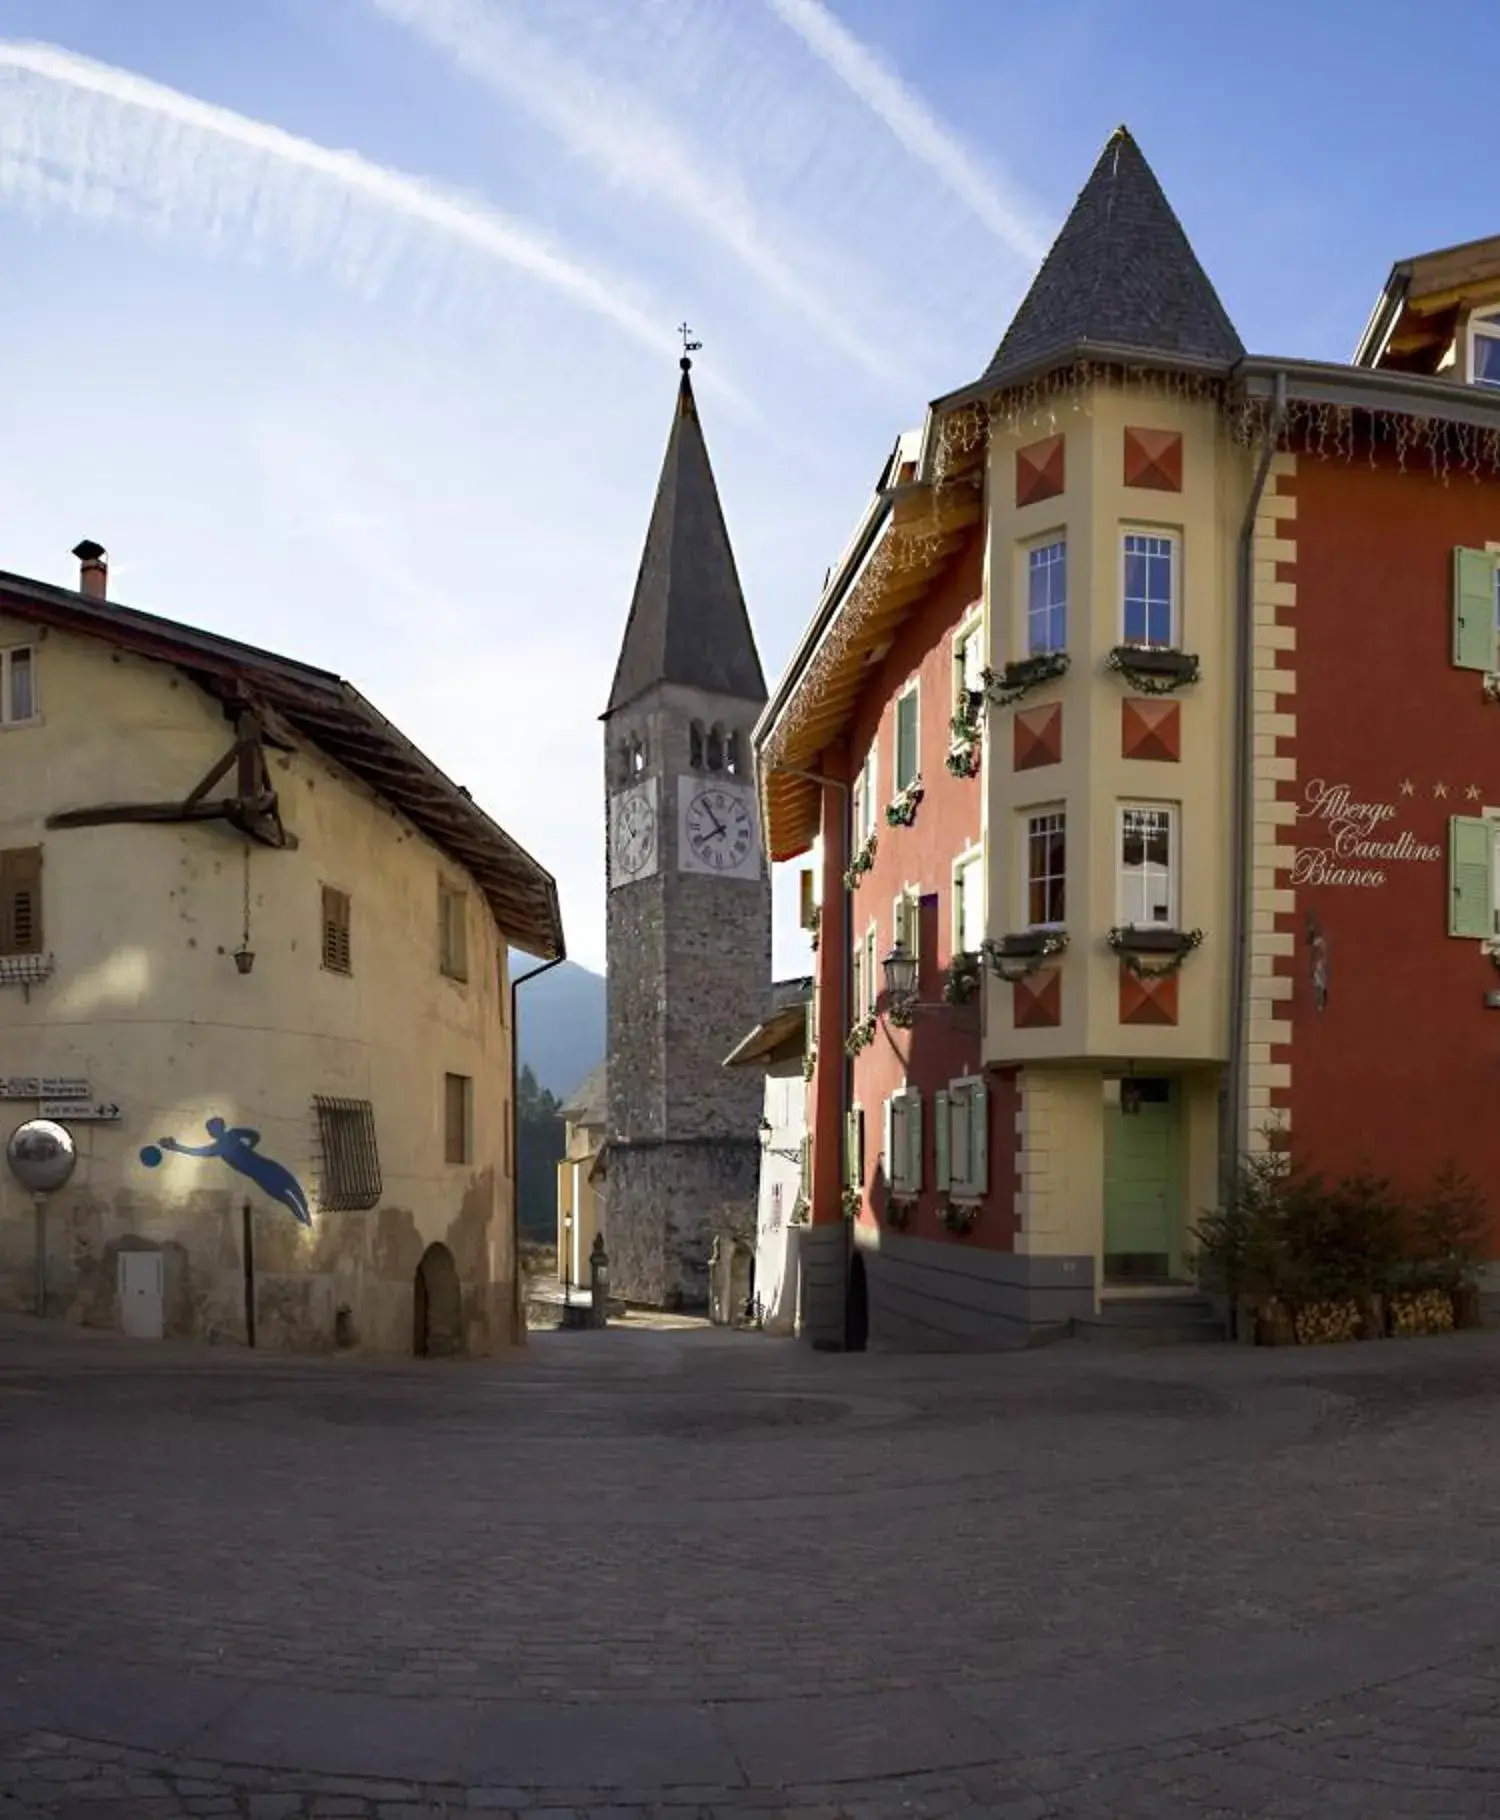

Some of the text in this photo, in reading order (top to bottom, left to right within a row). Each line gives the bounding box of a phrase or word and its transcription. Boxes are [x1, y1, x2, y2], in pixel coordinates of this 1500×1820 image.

[1297, 778, 1396, 837] Albergo
[1328, 818, 1441, 861] Cavallino
[1290, 848, 1387, 887] Bianco
